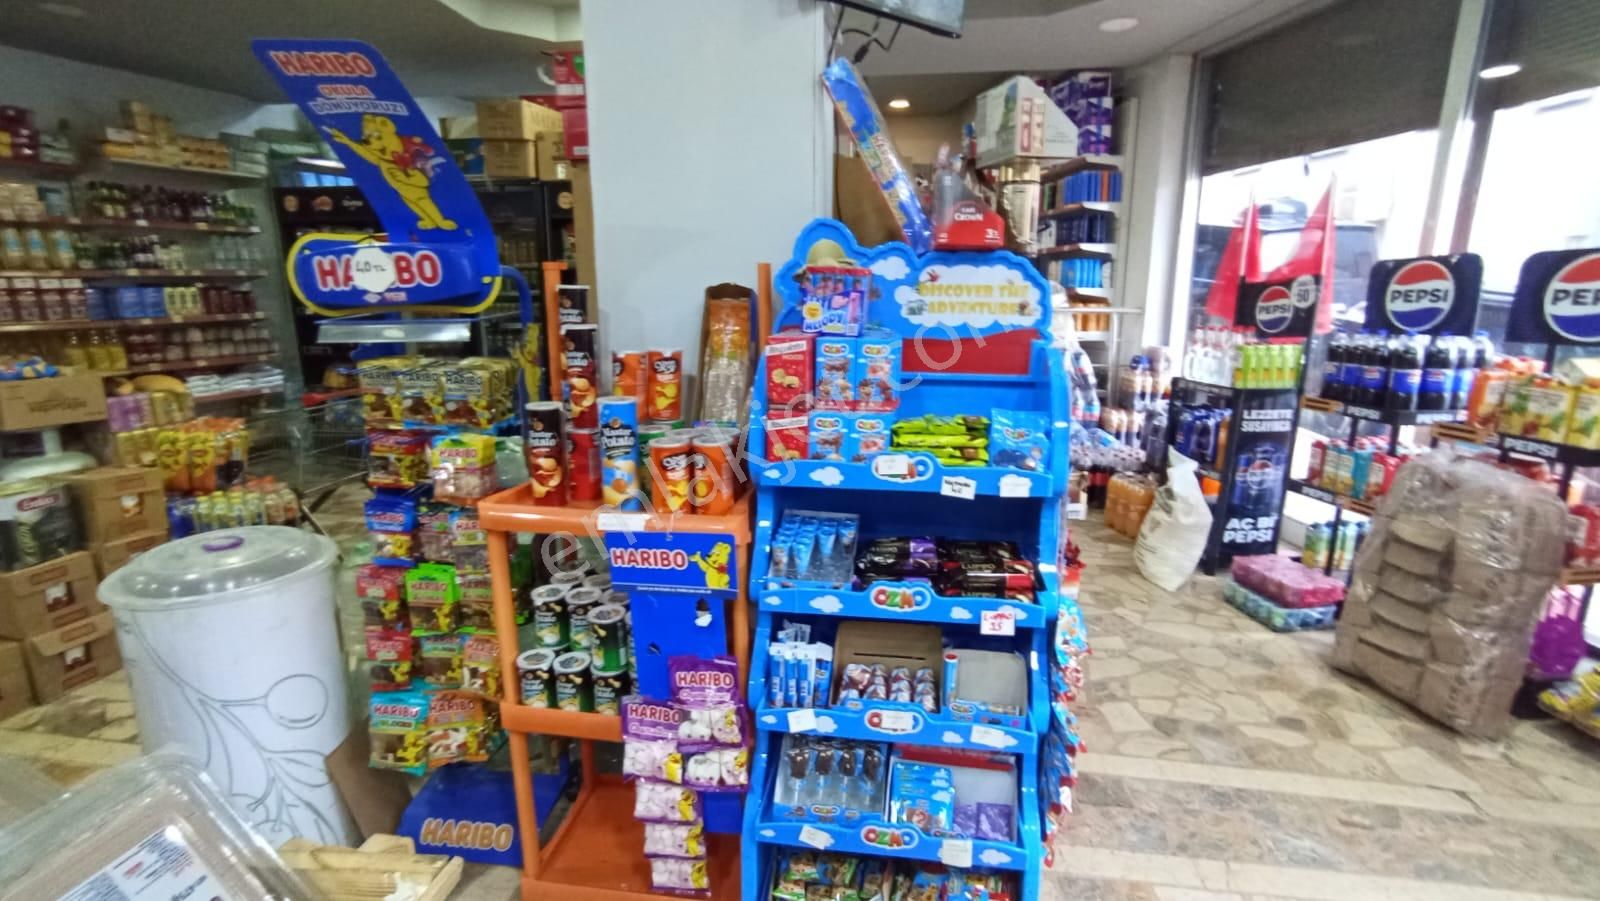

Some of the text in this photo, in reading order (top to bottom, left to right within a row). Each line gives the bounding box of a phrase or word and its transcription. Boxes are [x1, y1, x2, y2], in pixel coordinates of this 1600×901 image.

[269, 51, 376, 77] HARIBO
[318, 84, 375, 99] OKULA
[312, 251, 442, 291] HABO
[919, 284, 993, 297] DISCOVER
[1391, 288, 1449, 304] PEPSI
[928, 301, 1018, 315] ADVENTURE
[1259, 304, 1292, 315] PEPSI
[601, 436, 636, 448] Potato
[1504, 437, 1558, 458] PEPSI
[1222, 528, 1275, 544] PEPSI
[610, 548, 689, 570] HARIBO
[873, 588, 931, 608] OZMO
[676, 671, 735, 688] HARIBO
[374, 704, 419, 718] HARIBO
[628, 704, 682, 724] HARIBO
[420, 818, 514, 852] HARIBO
[864, 827, 918, 846] OZMO
